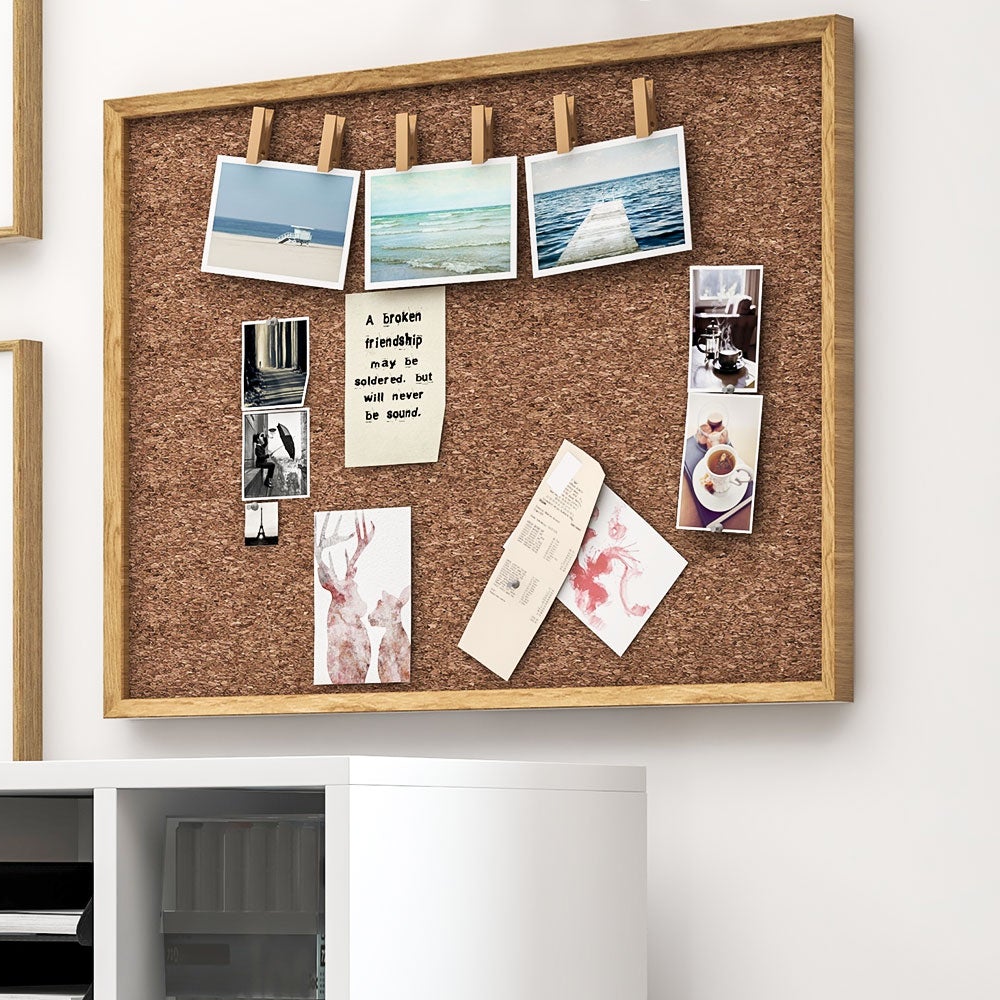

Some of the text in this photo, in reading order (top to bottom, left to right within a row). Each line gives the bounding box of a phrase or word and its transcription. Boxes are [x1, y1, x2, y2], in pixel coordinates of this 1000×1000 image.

[365, 311, 422, 326] A broken
[365, 333, 422, 349] friendship
[370, 357, 418, 369] may be
[415, 372, 433, 383] but
[363, 391, 424, 402] will never
[365, 407, 421, 421] be sound.
